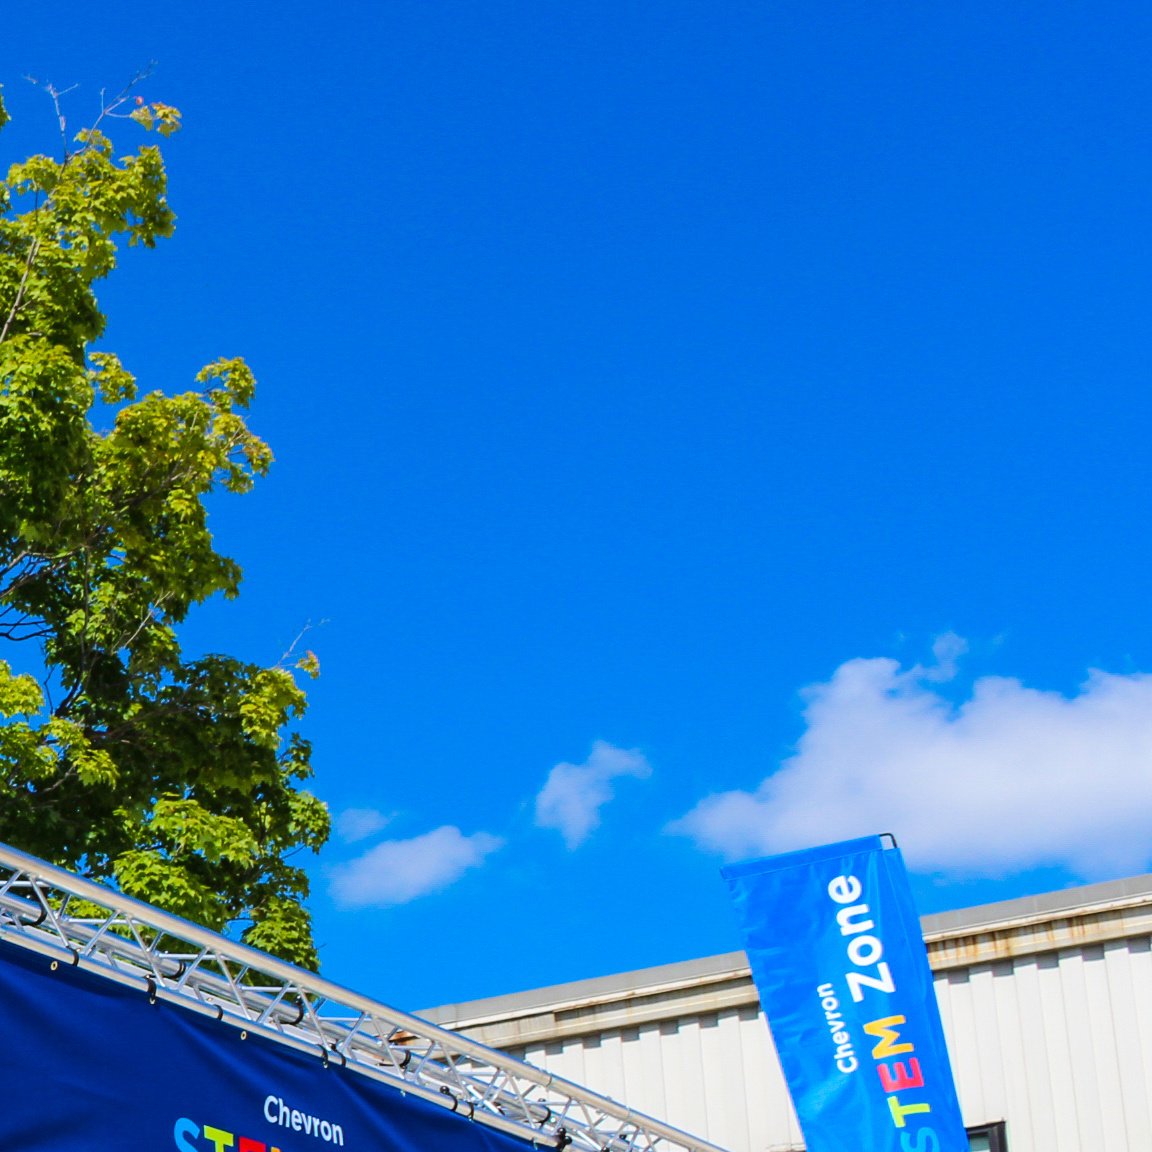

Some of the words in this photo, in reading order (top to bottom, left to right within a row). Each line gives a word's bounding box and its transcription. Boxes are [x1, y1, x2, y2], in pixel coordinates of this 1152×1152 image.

[828, 874, 896, 1003] Zone
[816, 982, 858, 1073] Chevron
[263, 1095, 344, 1146] Chevron
